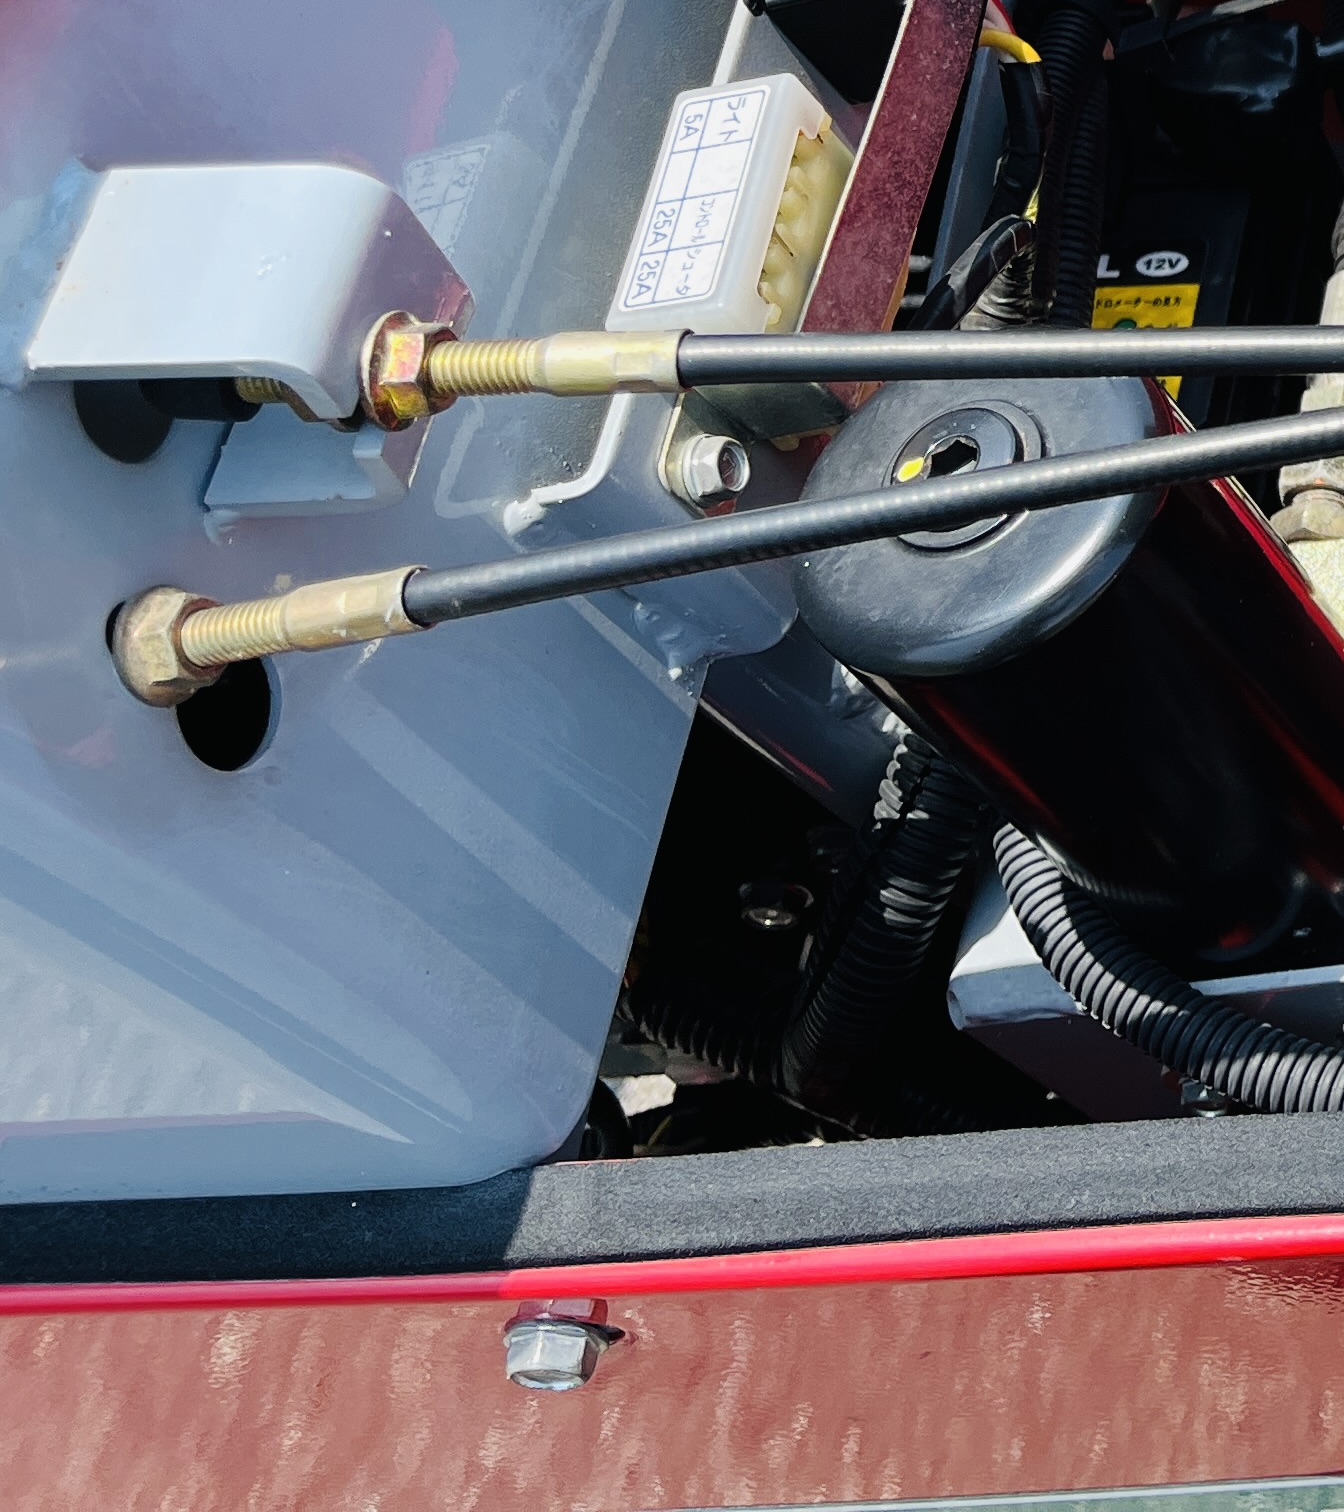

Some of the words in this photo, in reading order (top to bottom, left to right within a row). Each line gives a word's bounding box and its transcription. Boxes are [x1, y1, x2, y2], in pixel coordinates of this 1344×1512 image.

[679, 113, 703, 141] 5A
[719, 96, 747, 142] ライト
[647, 207, 676, 248] 25A
[690, 198, 715, 244] コントロール
[631, 259, 660, 300] 25A
[675, 248, 702, 296] シュータ
[1143, 257, 1182, 271] 12V
